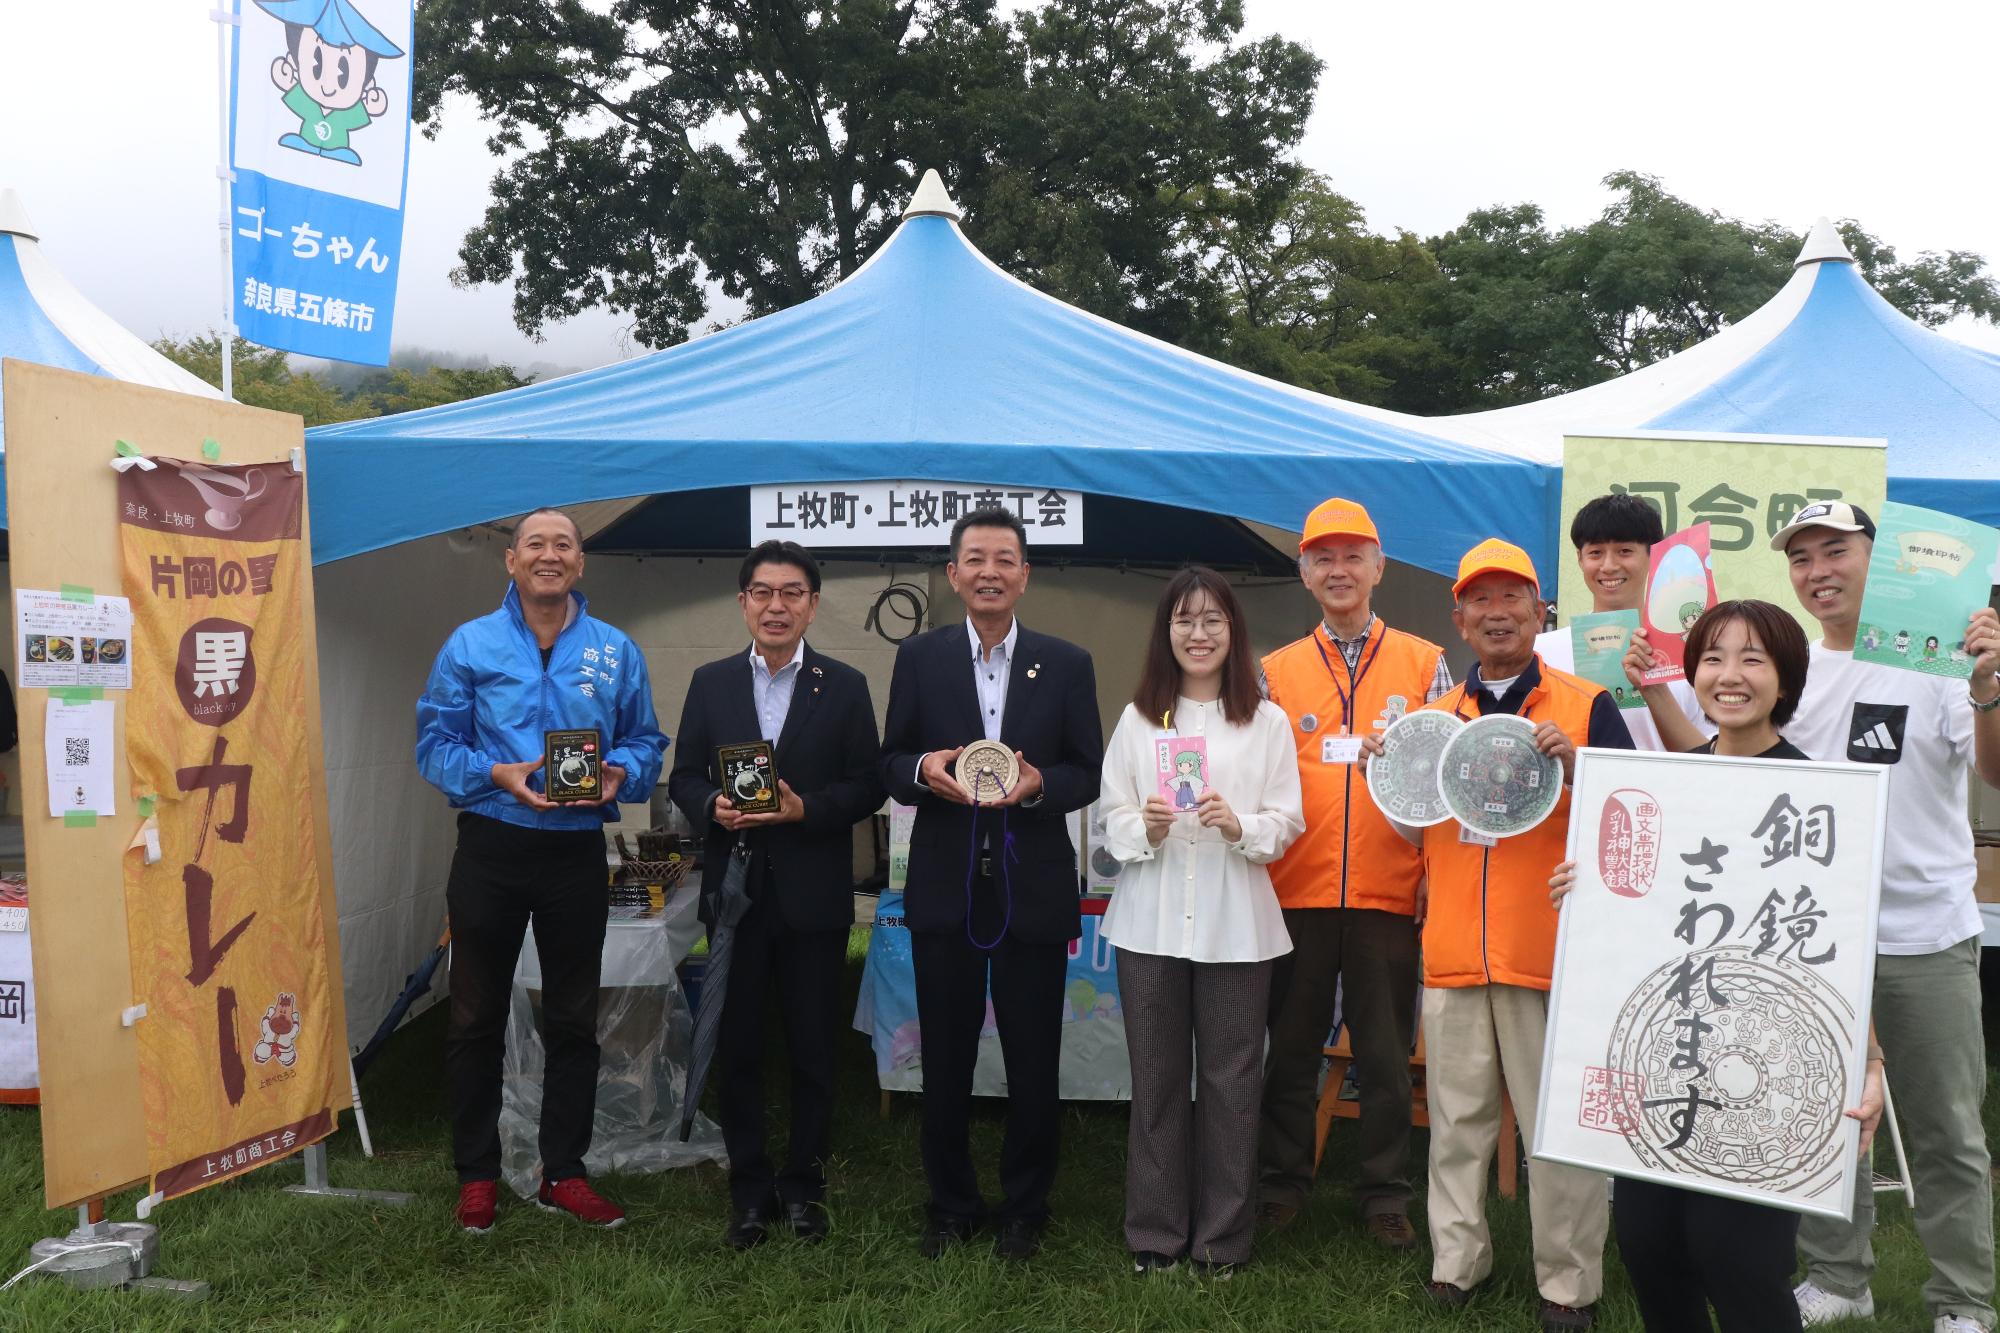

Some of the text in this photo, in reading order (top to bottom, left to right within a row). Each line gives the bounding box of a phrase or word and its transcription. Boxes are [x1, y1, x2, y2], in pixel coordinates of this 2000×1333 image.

[237, 205, 389, 274] ゴーちゃん
[243, 277, 375, 333] 奈良県五條市
[125, 502, 197, 529] 奈良・上牧町
[193, 631, 246, 698] 黒
[194, 702, 223, 715] black
[1739, 792, 1837, 967] 銅鏡
[176, 736, 258, 1108] カレー
[1643, 836, 1735, 1152] さわれます
[202, 1130, 297, 1178] 上牧町商工会
